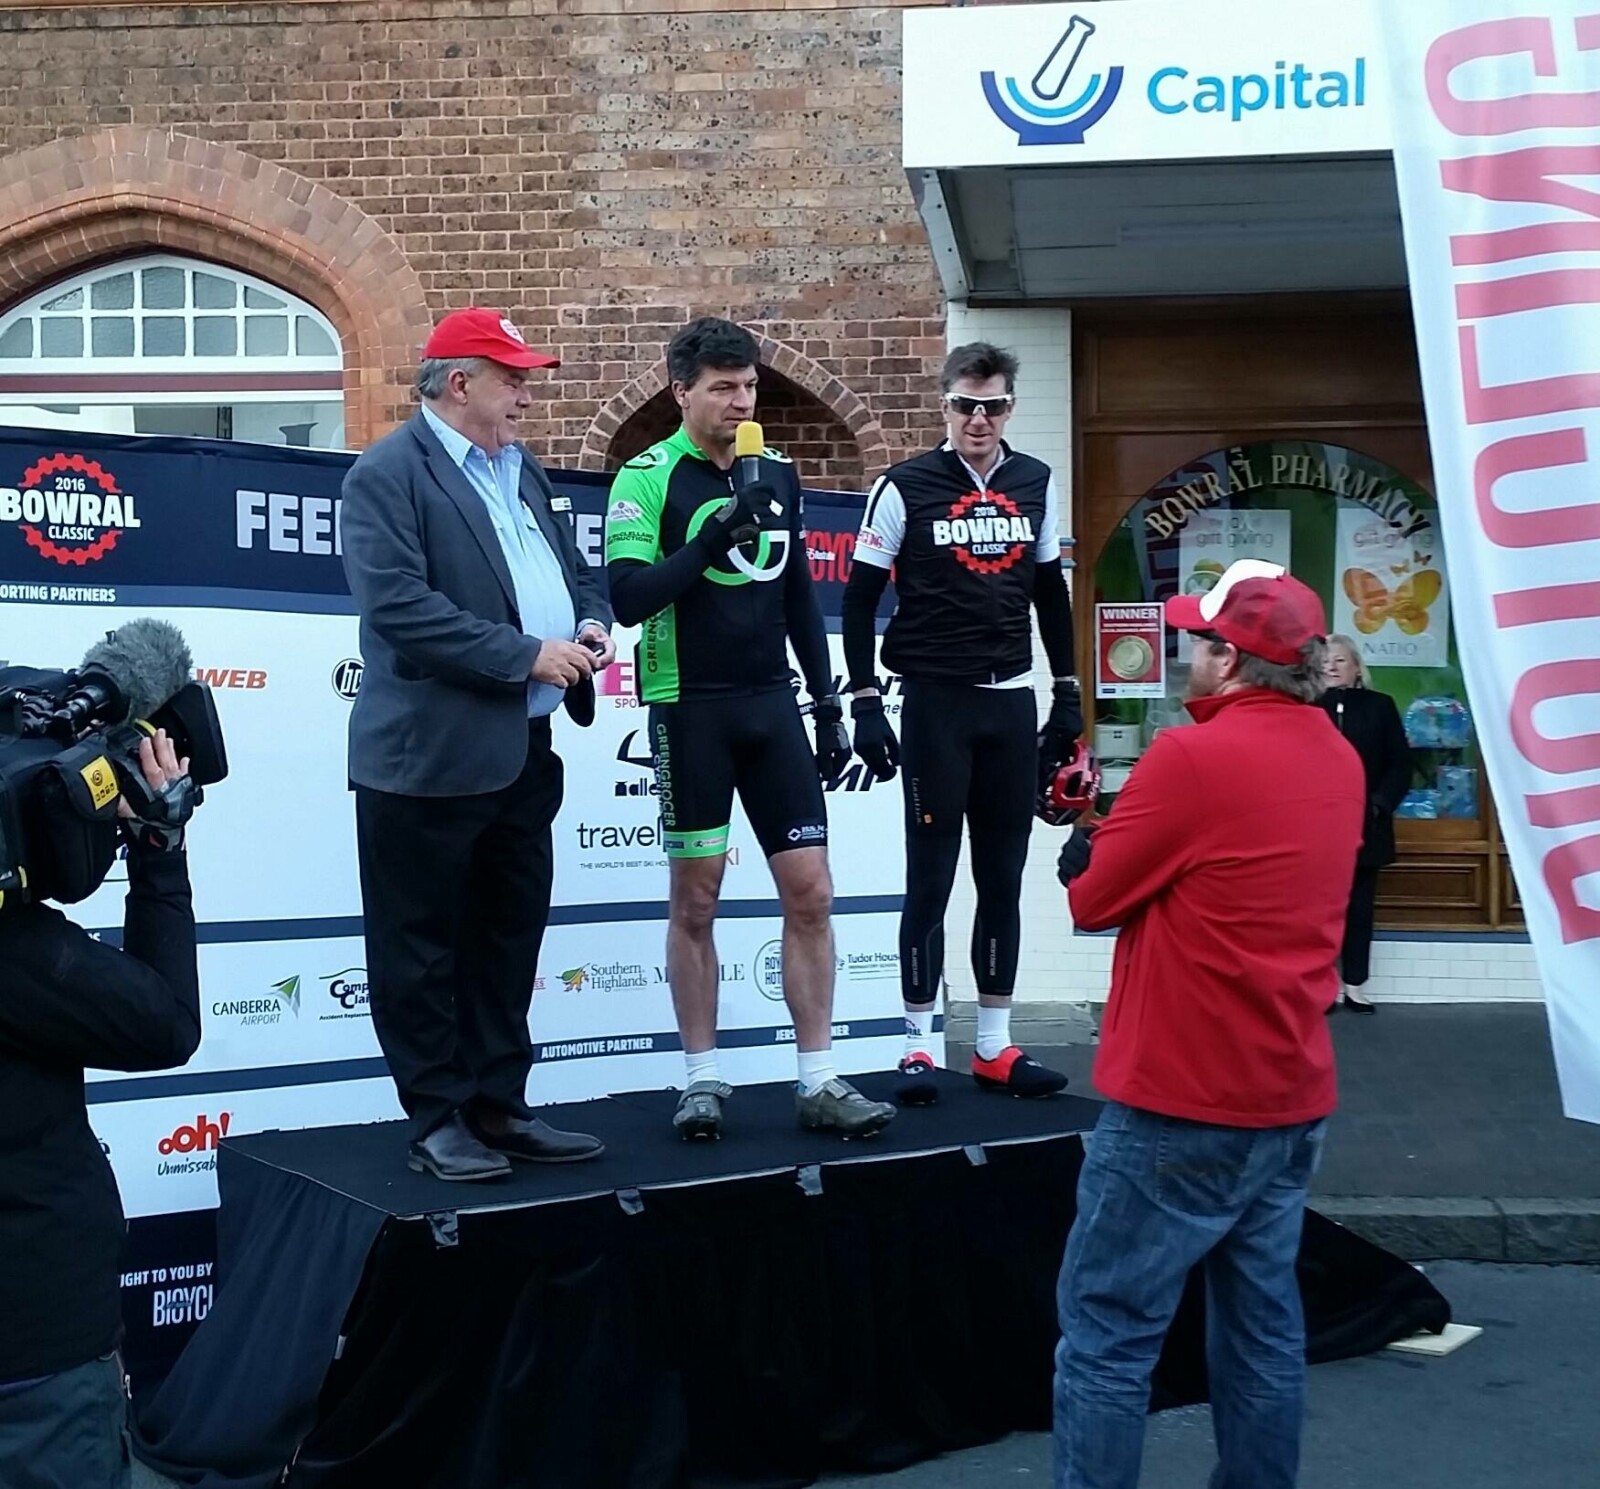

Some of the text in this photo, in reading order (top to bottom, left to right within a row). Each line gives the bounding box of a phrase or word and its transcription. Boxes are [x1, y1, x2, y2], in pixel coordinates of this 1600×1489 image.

[1147, 57, 1366, 122] Capital
[55, 477, 86, 491] 2016
[1145, 458, 1262, 539] BOWRAL
[1271, 454, 1432, 532] PHARMACY
[0, 488, 141, 528] BOWRAL
[974, 506, 997, 517] 2016
[236, 489, 343, 556] FEE
[932, 517, 1035, 546] BOWRAL
[48, 525, 95, 541] CLASSIC
[972, 543, 1007, 555] CLASSIC
[0, 585, 117, 602] ORTING PARTNERS
[1102, 608, 1159, 620] WINNER
[656, 723, 676, 828] GREENGROCER
[577, 815, 666, 850] travel
[764, 956, 782, 970] ROY
[847, 952, 900, 964] Tudor Hous
[591, 961, 641, 976] Southern
[592, 974, 648, 992] Highlands
[765, 971, 782, 985] HOT
[330, 979, 369, 998] Comp
[212, 998, 281, 1016] CANBERRA
[340, 992, 370, 1010] Clai
[240, 1013, 281, 1026] AIRPORT
[775, 1028, 796, 1041] JERS
[541, 1037, 654, 1060] AUTOMOTIVE PARTNER
[157, 1155, 217, 1176] Unmissab
[151, 1268, 167, 1283] TO
[170, 1265, 194, 1281] YOU
[197, 1262, 214, 1278] BY
